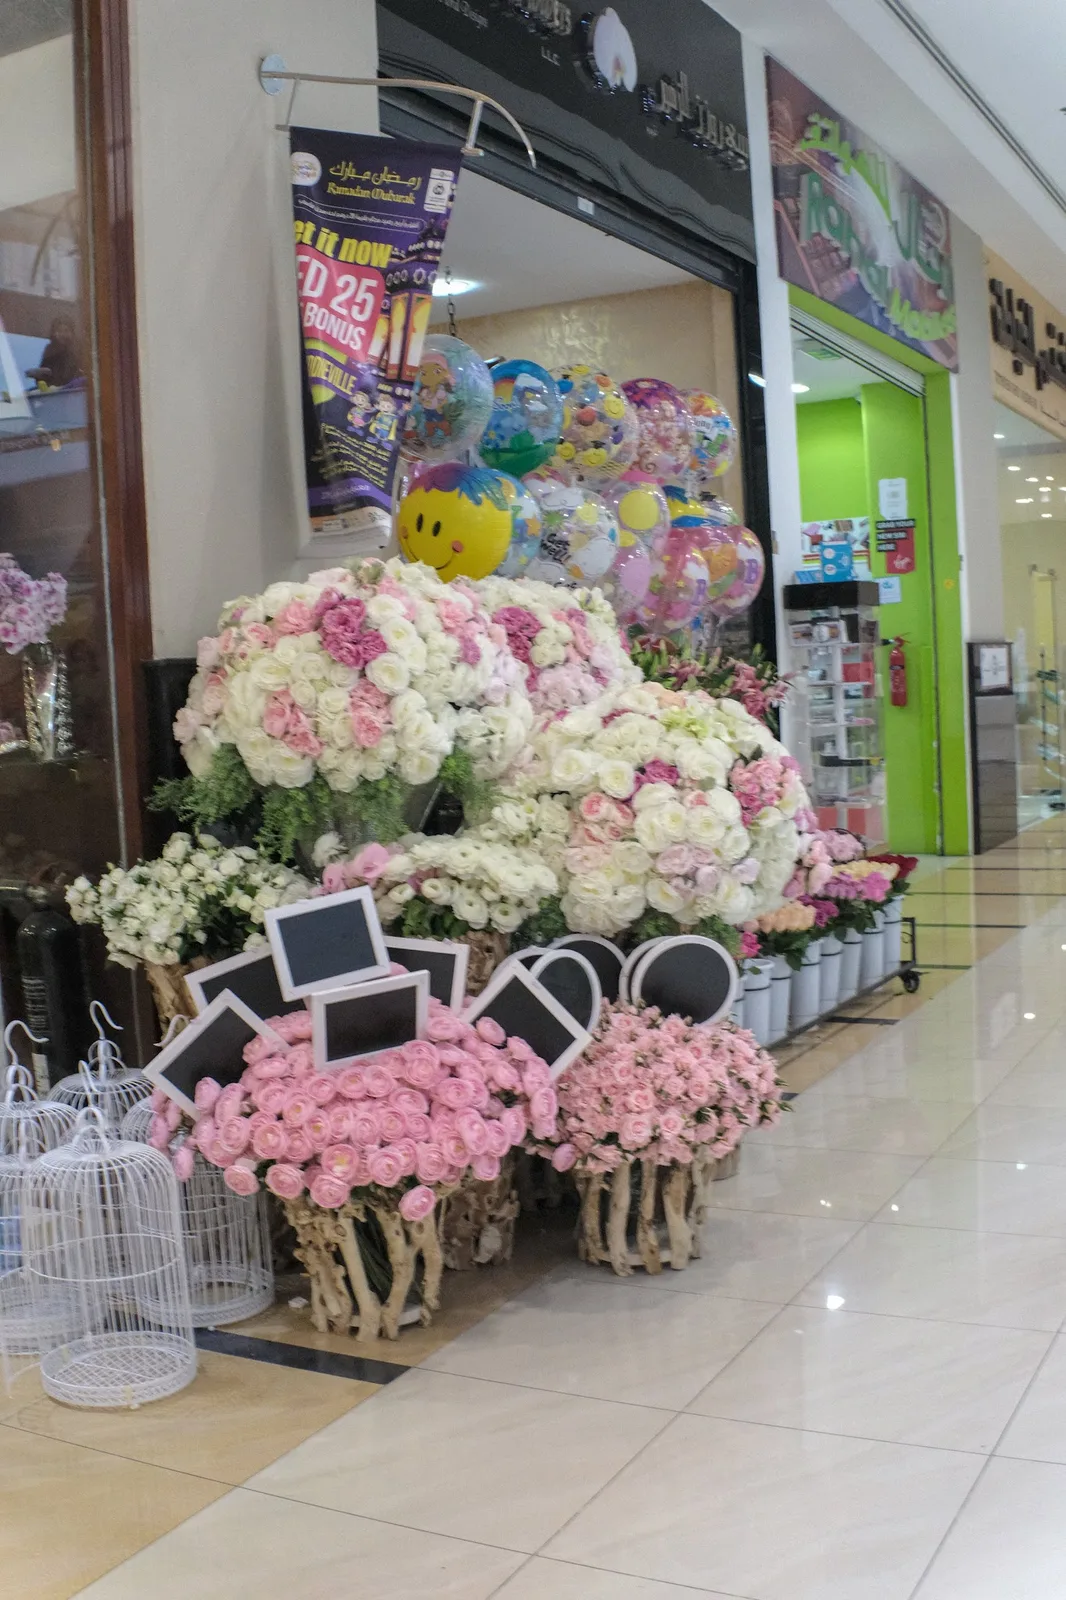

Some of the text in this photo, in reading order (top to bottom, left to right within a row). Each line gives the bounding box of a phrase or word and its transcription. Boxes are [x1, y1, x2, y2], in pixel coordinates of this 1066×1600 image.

[328, 160, 371, 181] مبارك
[371, 166, 423, 191] رمضان
[294, 220, 316, 246] et
[315, 227, 339, 258] it
[329, 274, 379, 322] 25
[303, 302, 366, 351] BONUS
